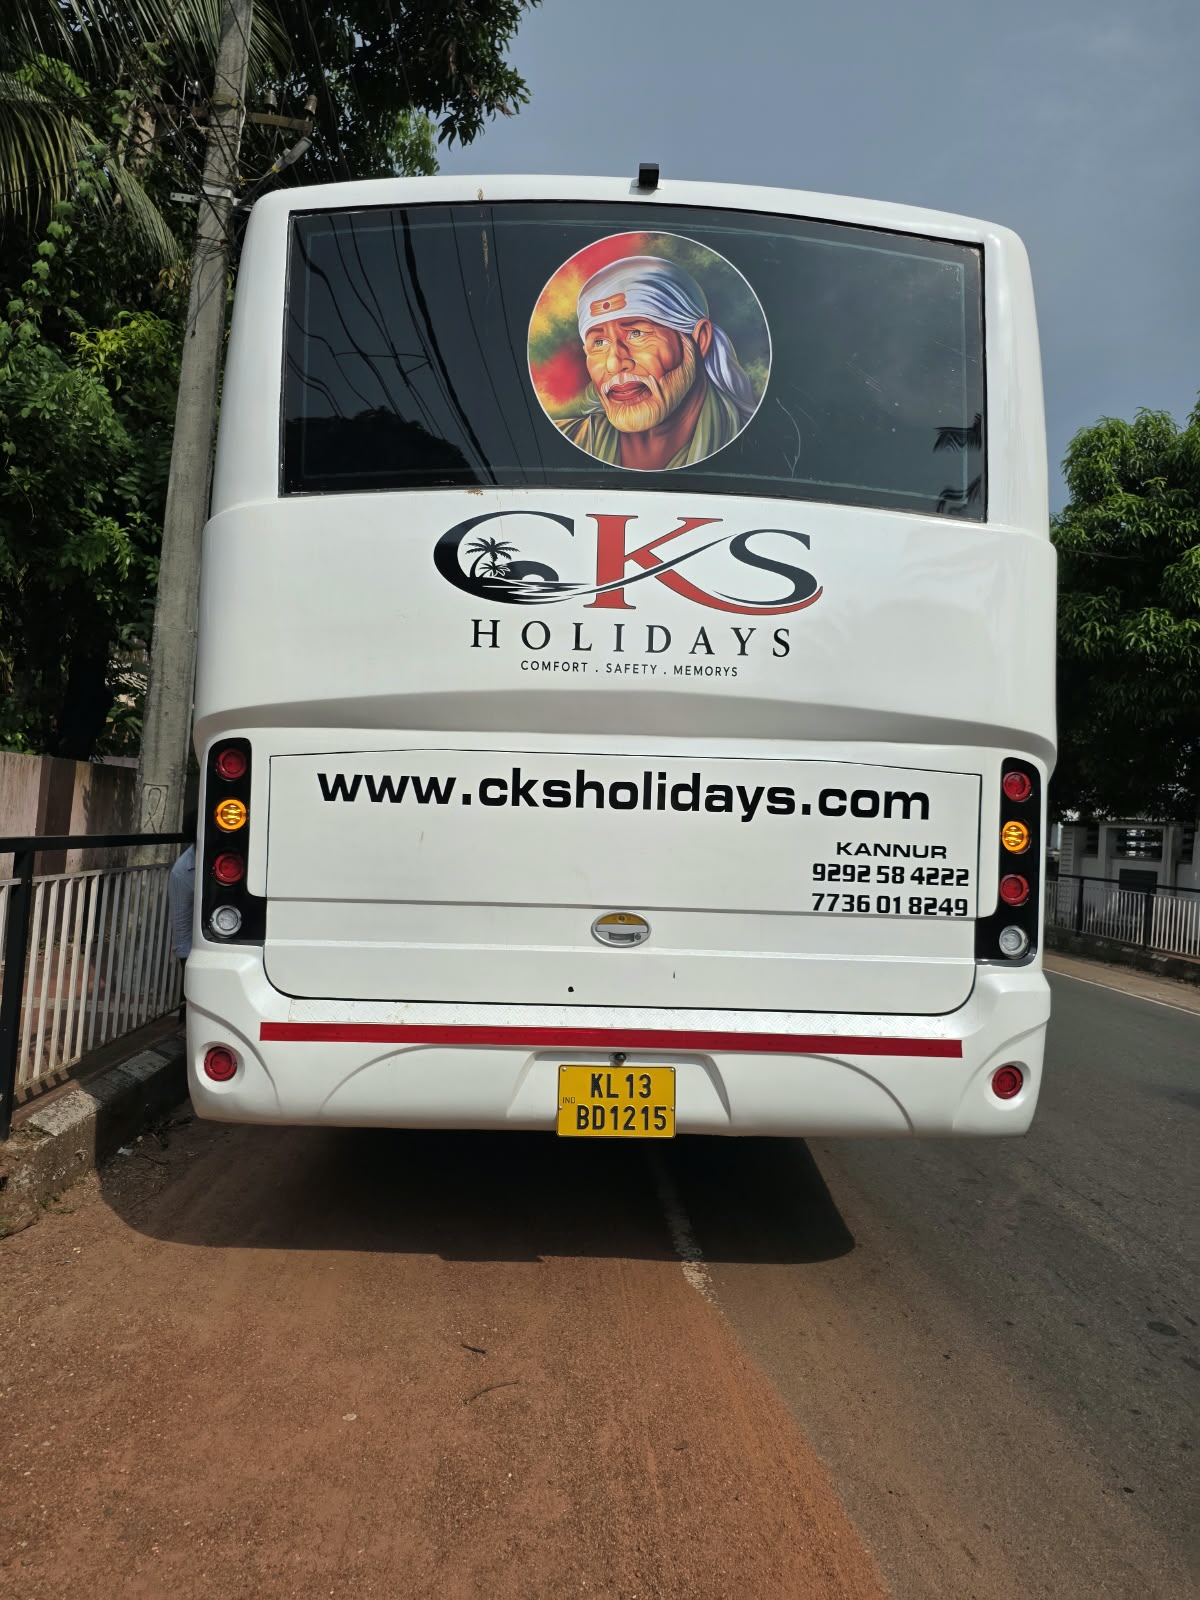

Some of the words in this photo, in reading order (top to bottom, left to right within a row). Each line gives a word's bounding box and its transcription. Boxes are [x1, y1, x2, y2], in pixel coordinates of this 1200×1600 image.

[433, 511, 823, 616] CKS
[470, 619, 791, 658] HOLIDAYS
[520, 660, 588, 673] COMFORT
[605, 663, 657, 675] SAFETY
[673, 665, 738, 677] MEMORYS
[316, 767, 930, 822] www.cksholidays.com
[836, 841, 947, 859] KANNUR
[812, 863, 871, 883] 9292
[876, 866, 905, 884] 58
[910, 867, 969, 887] 4222
[812, 893, 870, 913] 7736
[876, 896, 901, 914] 01
[908, 897, 968, 917] 8249
[576, 1105, 667, 1131] BD1215
